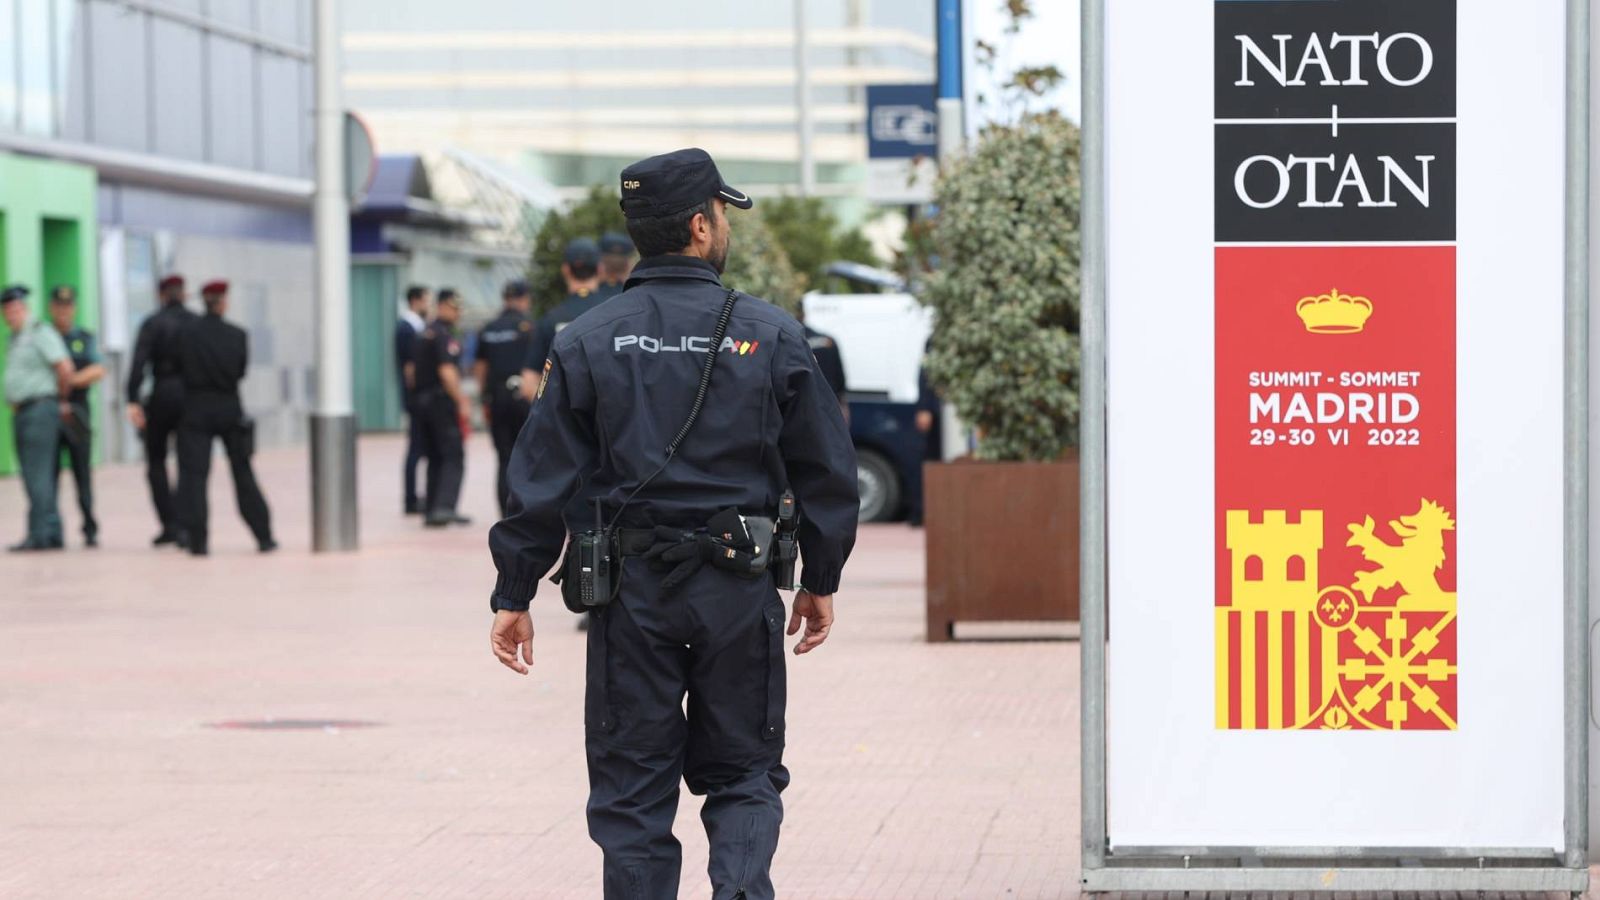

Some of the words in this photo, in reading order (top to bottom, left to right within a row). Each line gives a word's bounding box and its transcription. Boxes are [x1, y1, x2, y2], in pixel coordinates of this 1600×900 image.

[1234, 31, 1433, 87] NATO
[1233, 153, 1436, 209] OTAN
[614, 335, 738, 353] POLICA
[1249, 371, 1322, 387] SUMMIT
[1339, 371, 1421, 387] SOMMET
[1249, 392, 1420, 424] MADRID
[1249, 428, 1316, 446] 29-30
[1327, 428, 1349, 446] VI
[1367, 428, 1420, 446] 2022
